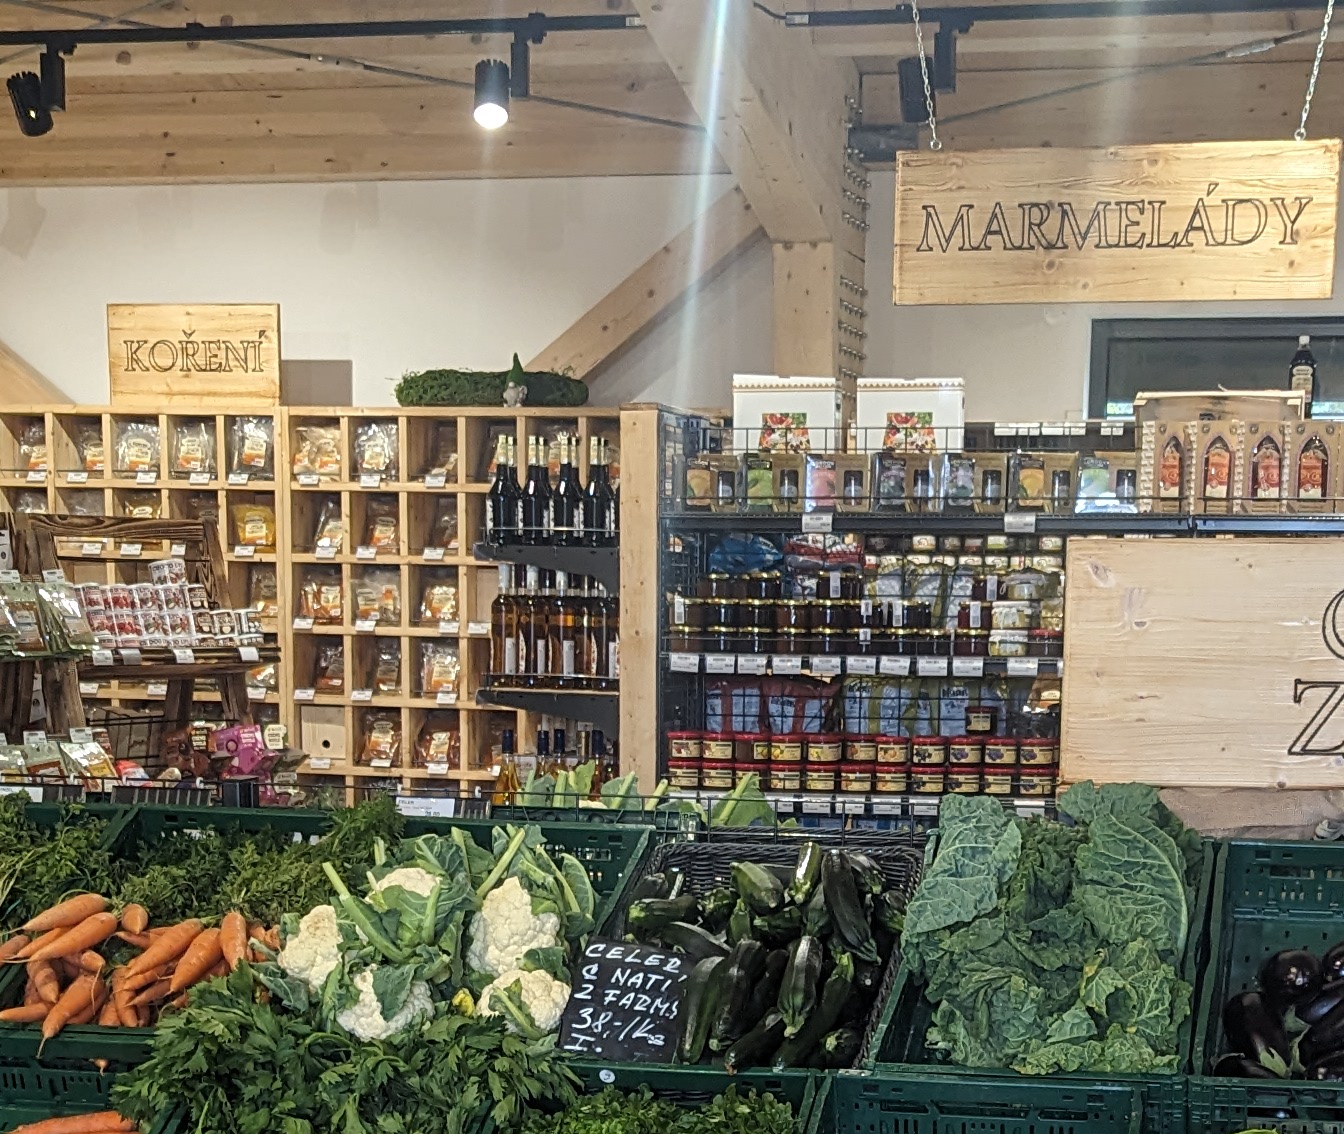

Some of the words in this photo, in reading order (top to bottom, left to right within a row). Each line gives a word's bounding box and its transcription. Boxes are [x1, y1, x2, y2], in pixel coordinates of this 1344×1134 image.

[916, 183, 1313, 253] MARMELÁDY
[124, 329, 265, 374] KOŘENÍ
[585, 944, 682, 973] CELER
